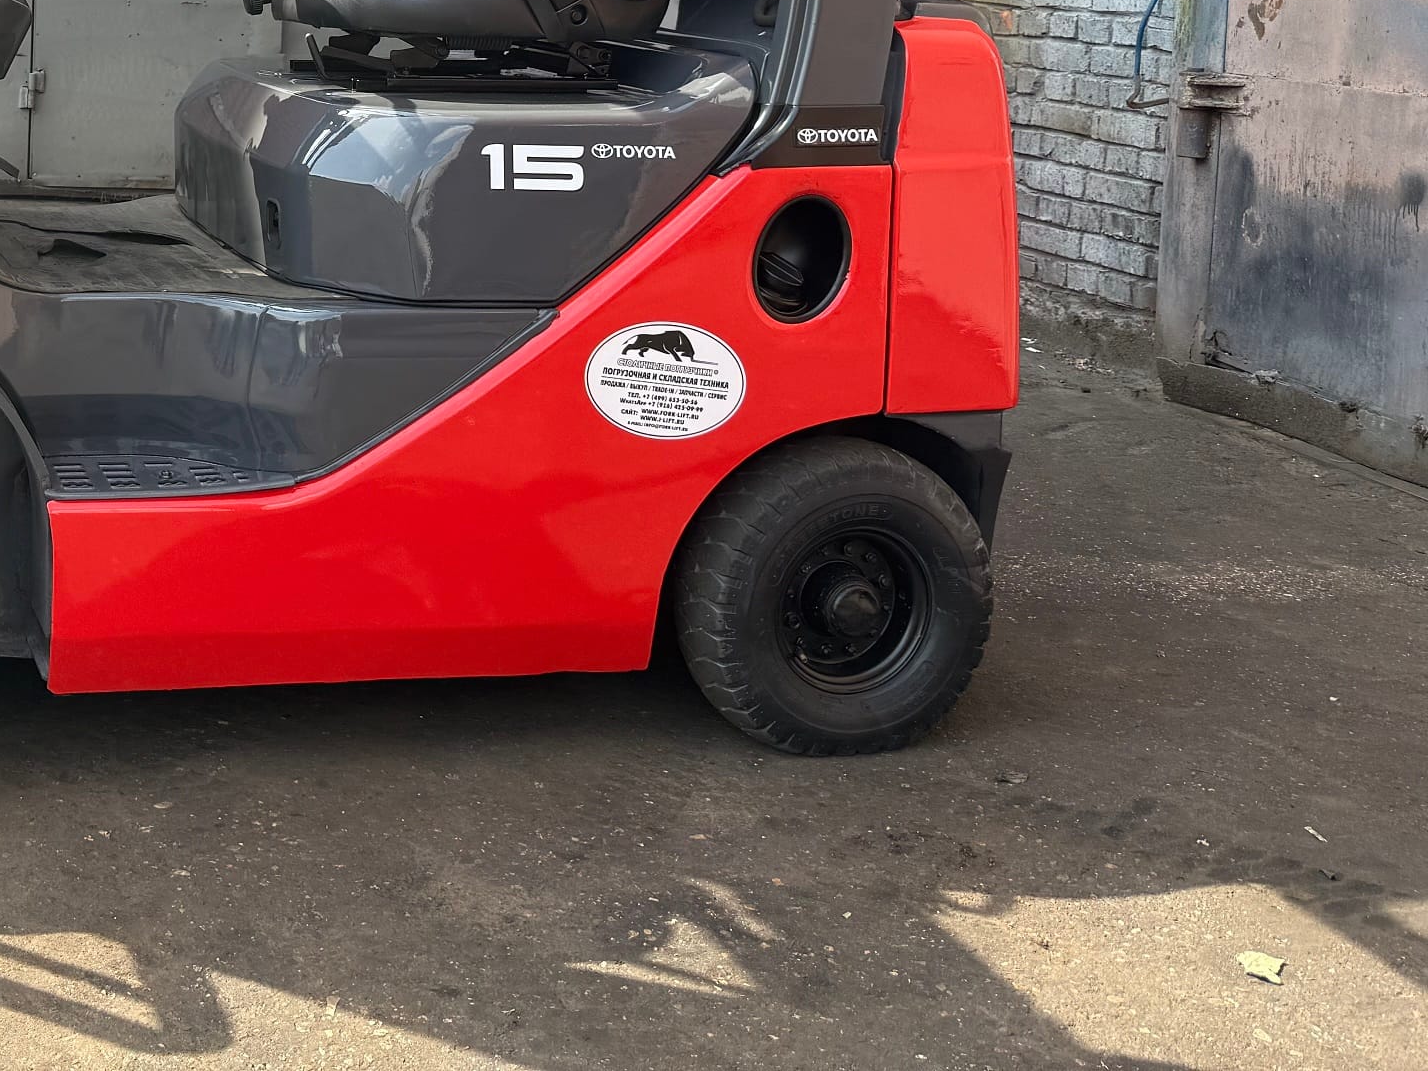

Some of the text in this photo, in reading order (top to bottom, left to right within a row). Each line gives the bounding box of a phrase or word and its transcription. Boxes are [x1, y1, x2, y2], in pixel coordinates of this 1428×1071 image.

[818, 129, 878, 143] TOYOTA
[613, 145, 677, 159] TOYOTA
[481, 143, 585, 192] 15
[617, 358, 664, 371] СТОЛИЧНЫЕ
[600, 379, 626, 388] ПРОДАЖА
[602, 367, 729, 389] ПОГРУЗОЧНАЯ И СКЛАДСКАЯ ТЕХНИКА
